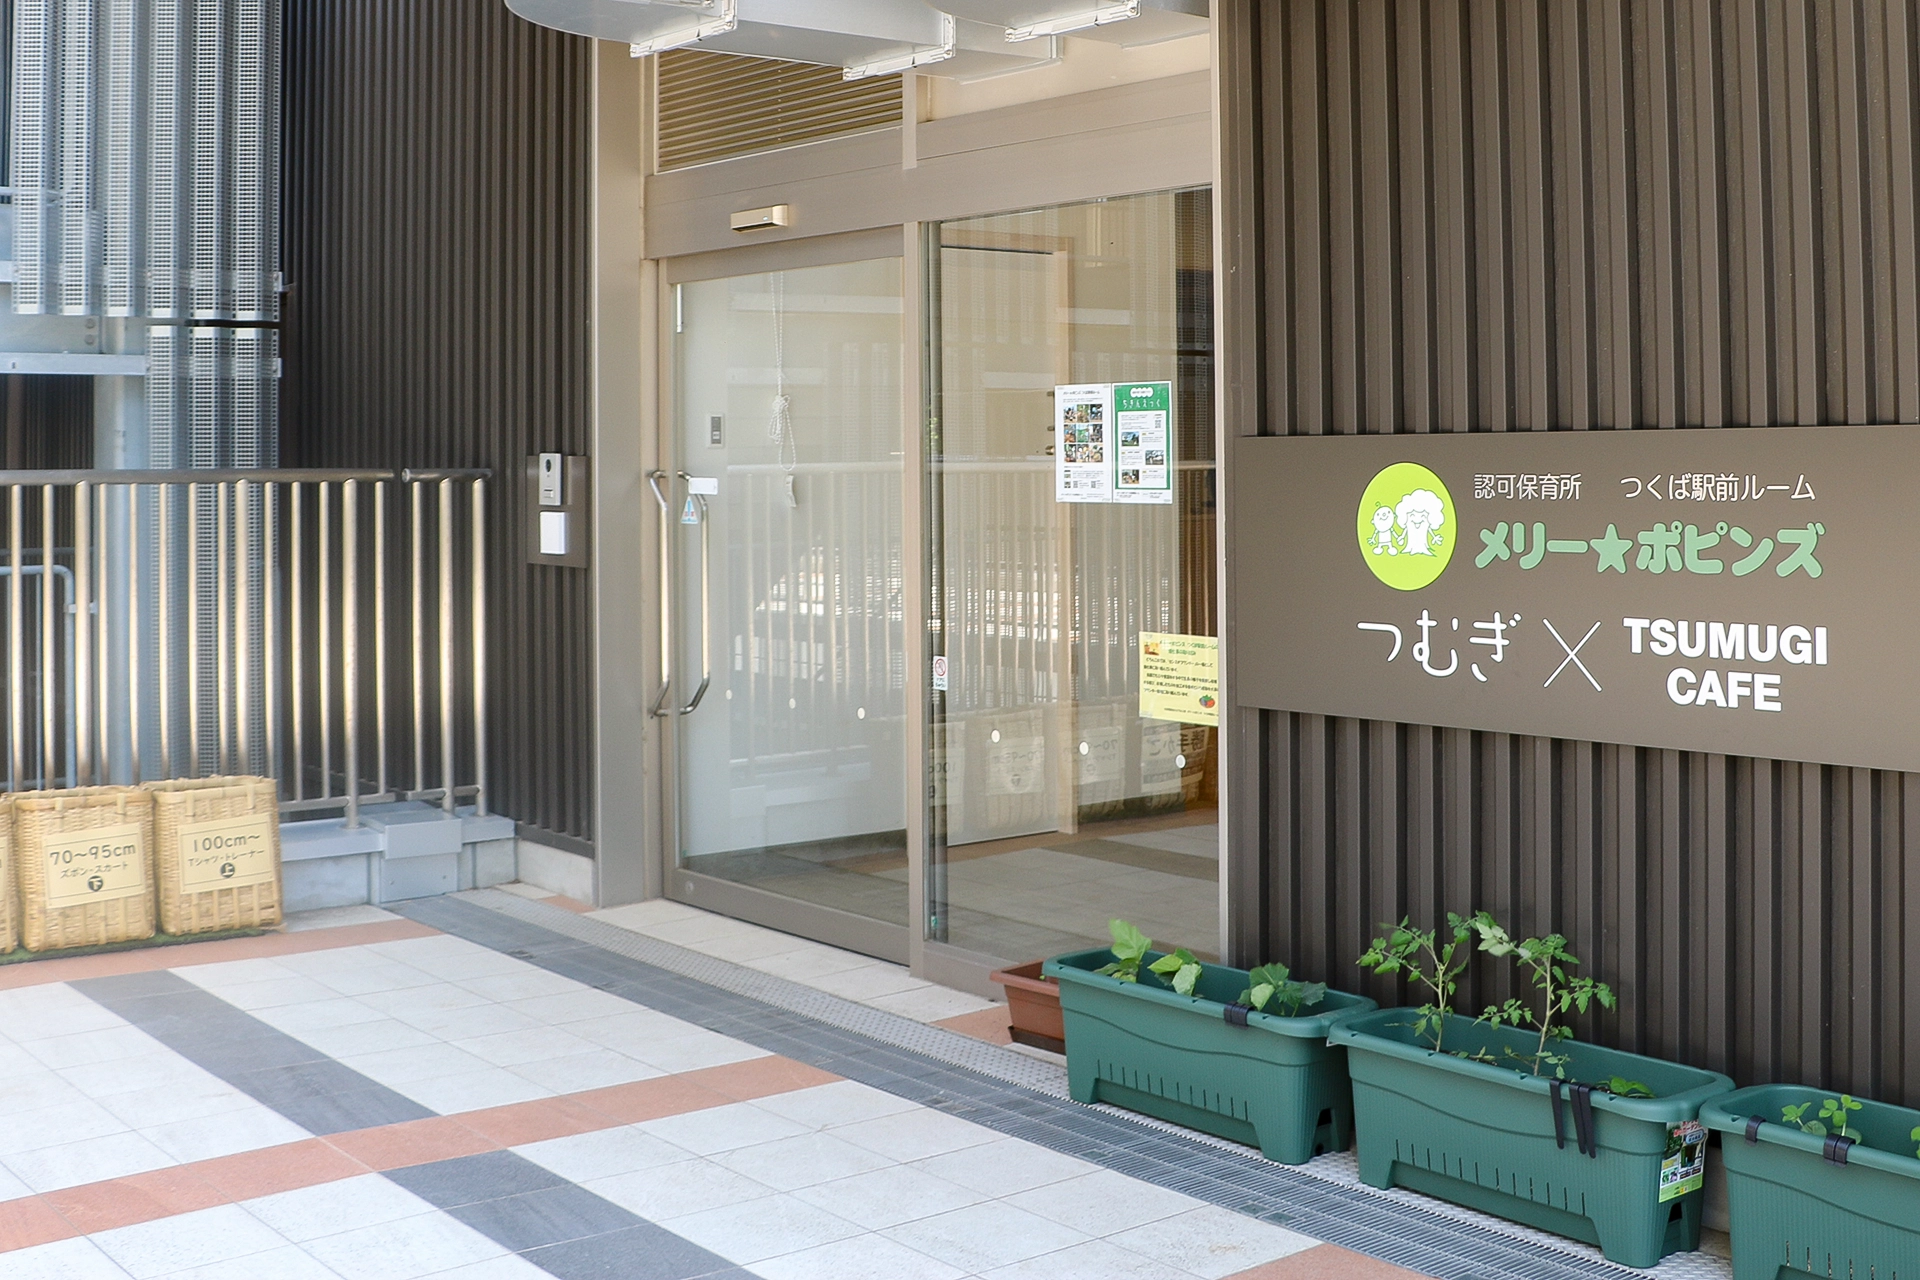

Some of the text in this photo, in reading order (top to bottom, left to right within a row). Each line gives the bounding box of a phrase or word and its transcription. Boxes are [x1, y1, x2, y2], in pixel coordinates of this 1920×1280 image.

[1474, 473, 1817, 503] 認可保育所 つくば駅前ルーム
[1357, 609, 1524, 683] つむぎ
[1623, 617, 1830, 666] TSUMUGI
[1666, 668, 1783, 713] CAFE
